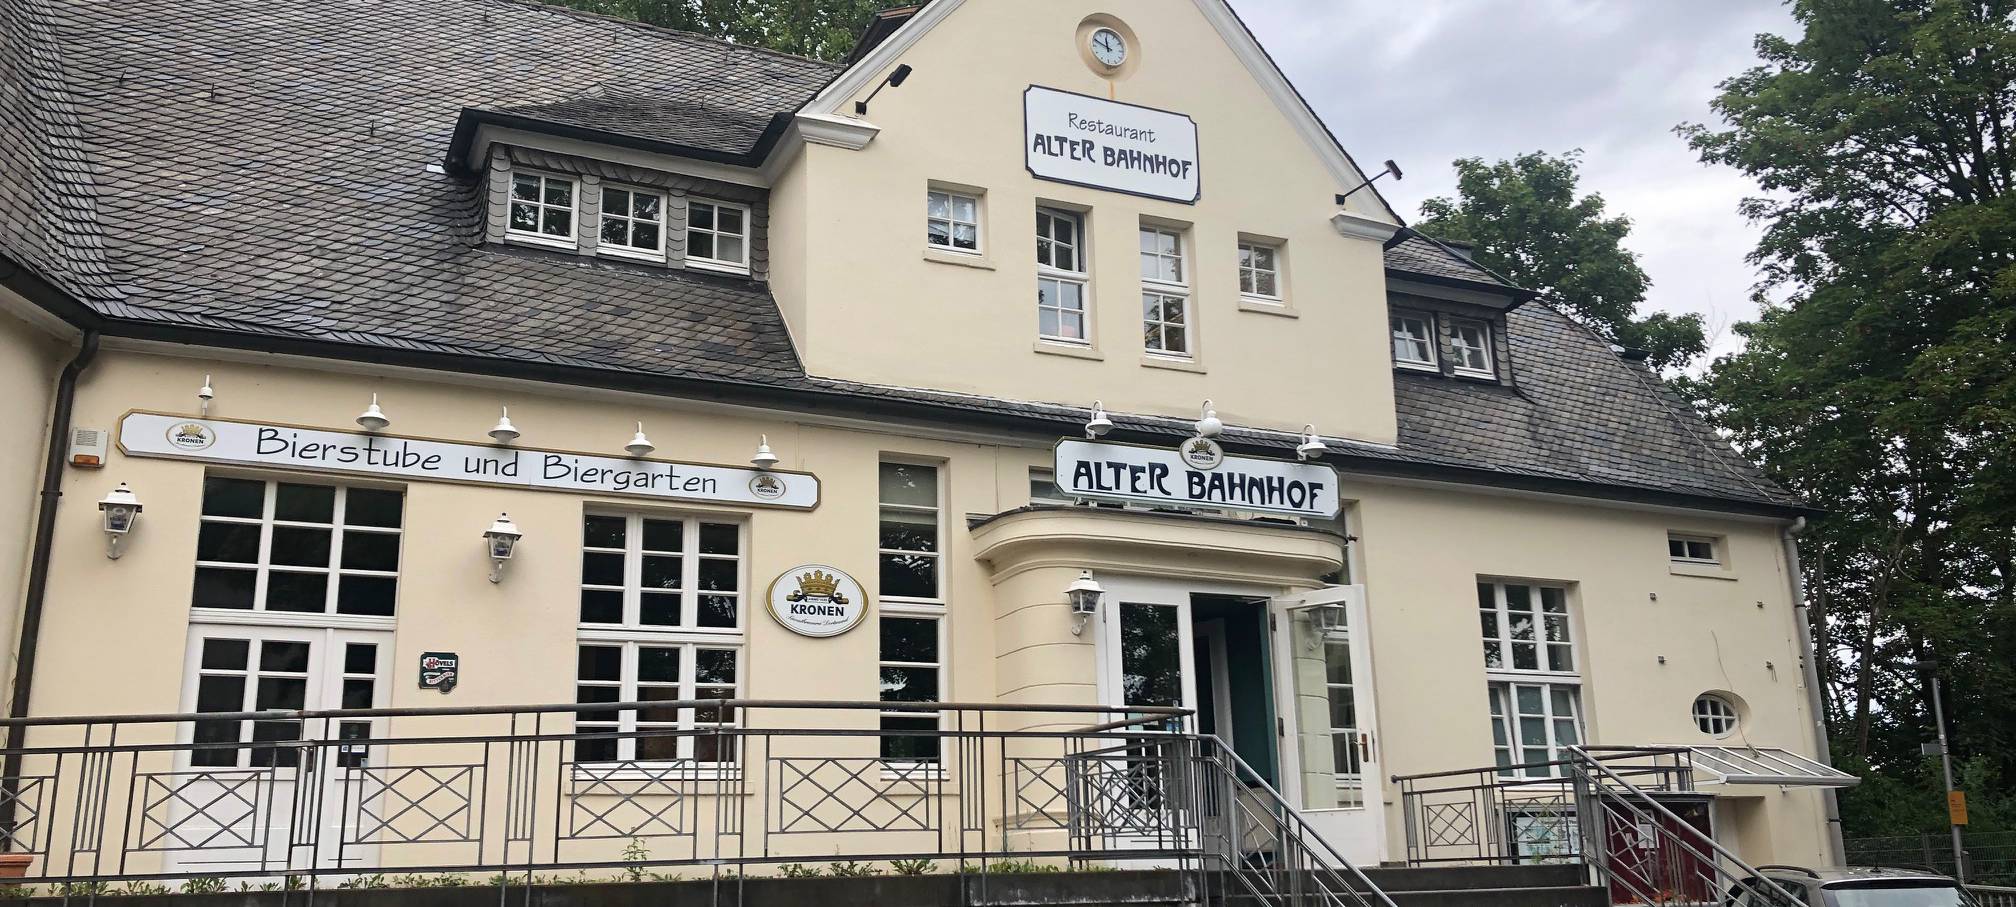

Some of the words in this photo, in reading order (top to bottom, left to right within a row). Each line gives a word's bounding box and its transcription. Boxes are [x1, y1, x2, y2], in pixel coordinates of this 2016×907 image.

[1068, 112, 1156, 143] Restaurant
[1033, 133, 1096, 163] ALTER
[1102, 145, 1192, 180] BAHNHOF
[256, 427, 442, 470] Bierstube
[464, 451, 519, 478] und
[543, 454, 717, 494] Biergarten
[1073, 460, 1172, 496] ALTER
[1185, 470, 1324, 510] BAHNHOF
[791, 604, 844, 616] KRONEN
